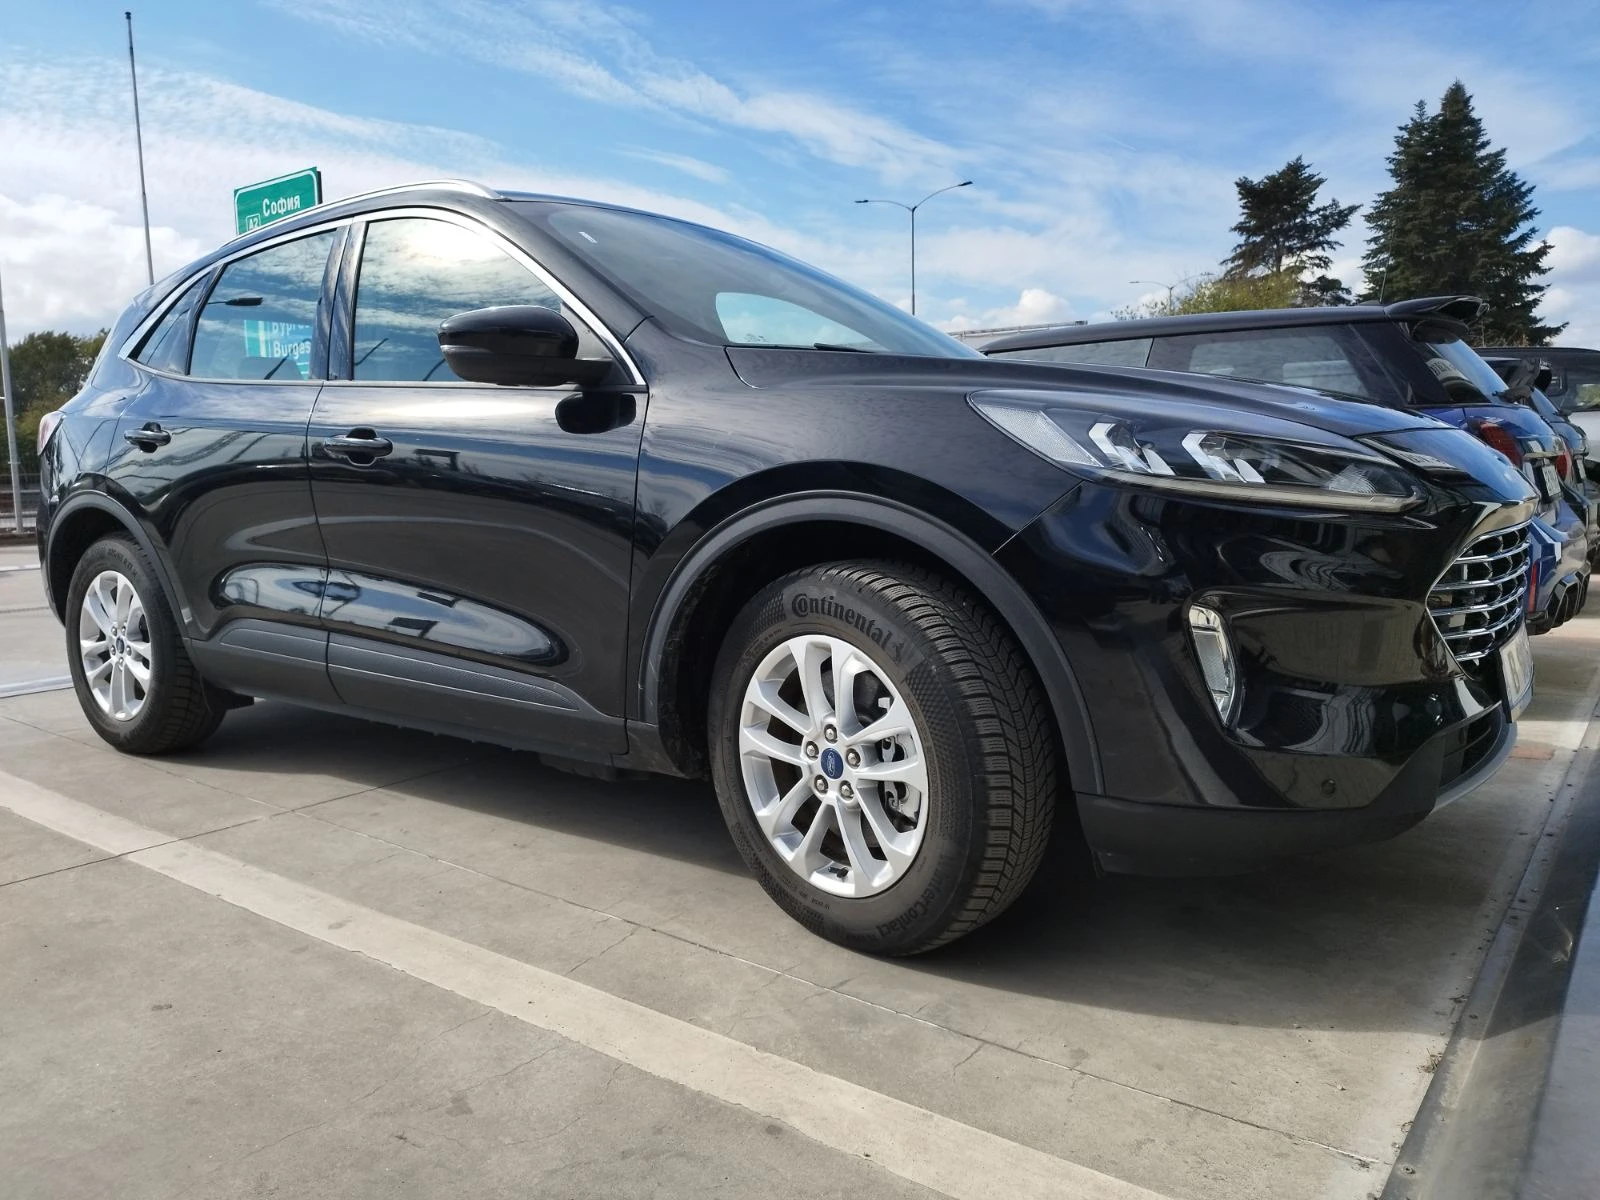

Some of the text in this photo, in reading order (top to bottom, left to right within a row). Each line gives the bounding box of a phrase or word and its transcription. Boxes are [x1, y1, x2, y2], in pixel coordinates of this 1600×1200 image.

[262, 195, 301, 217] София
[273, 341, 312, 360] Burgas
[792, 593, 893, 651] Continental
